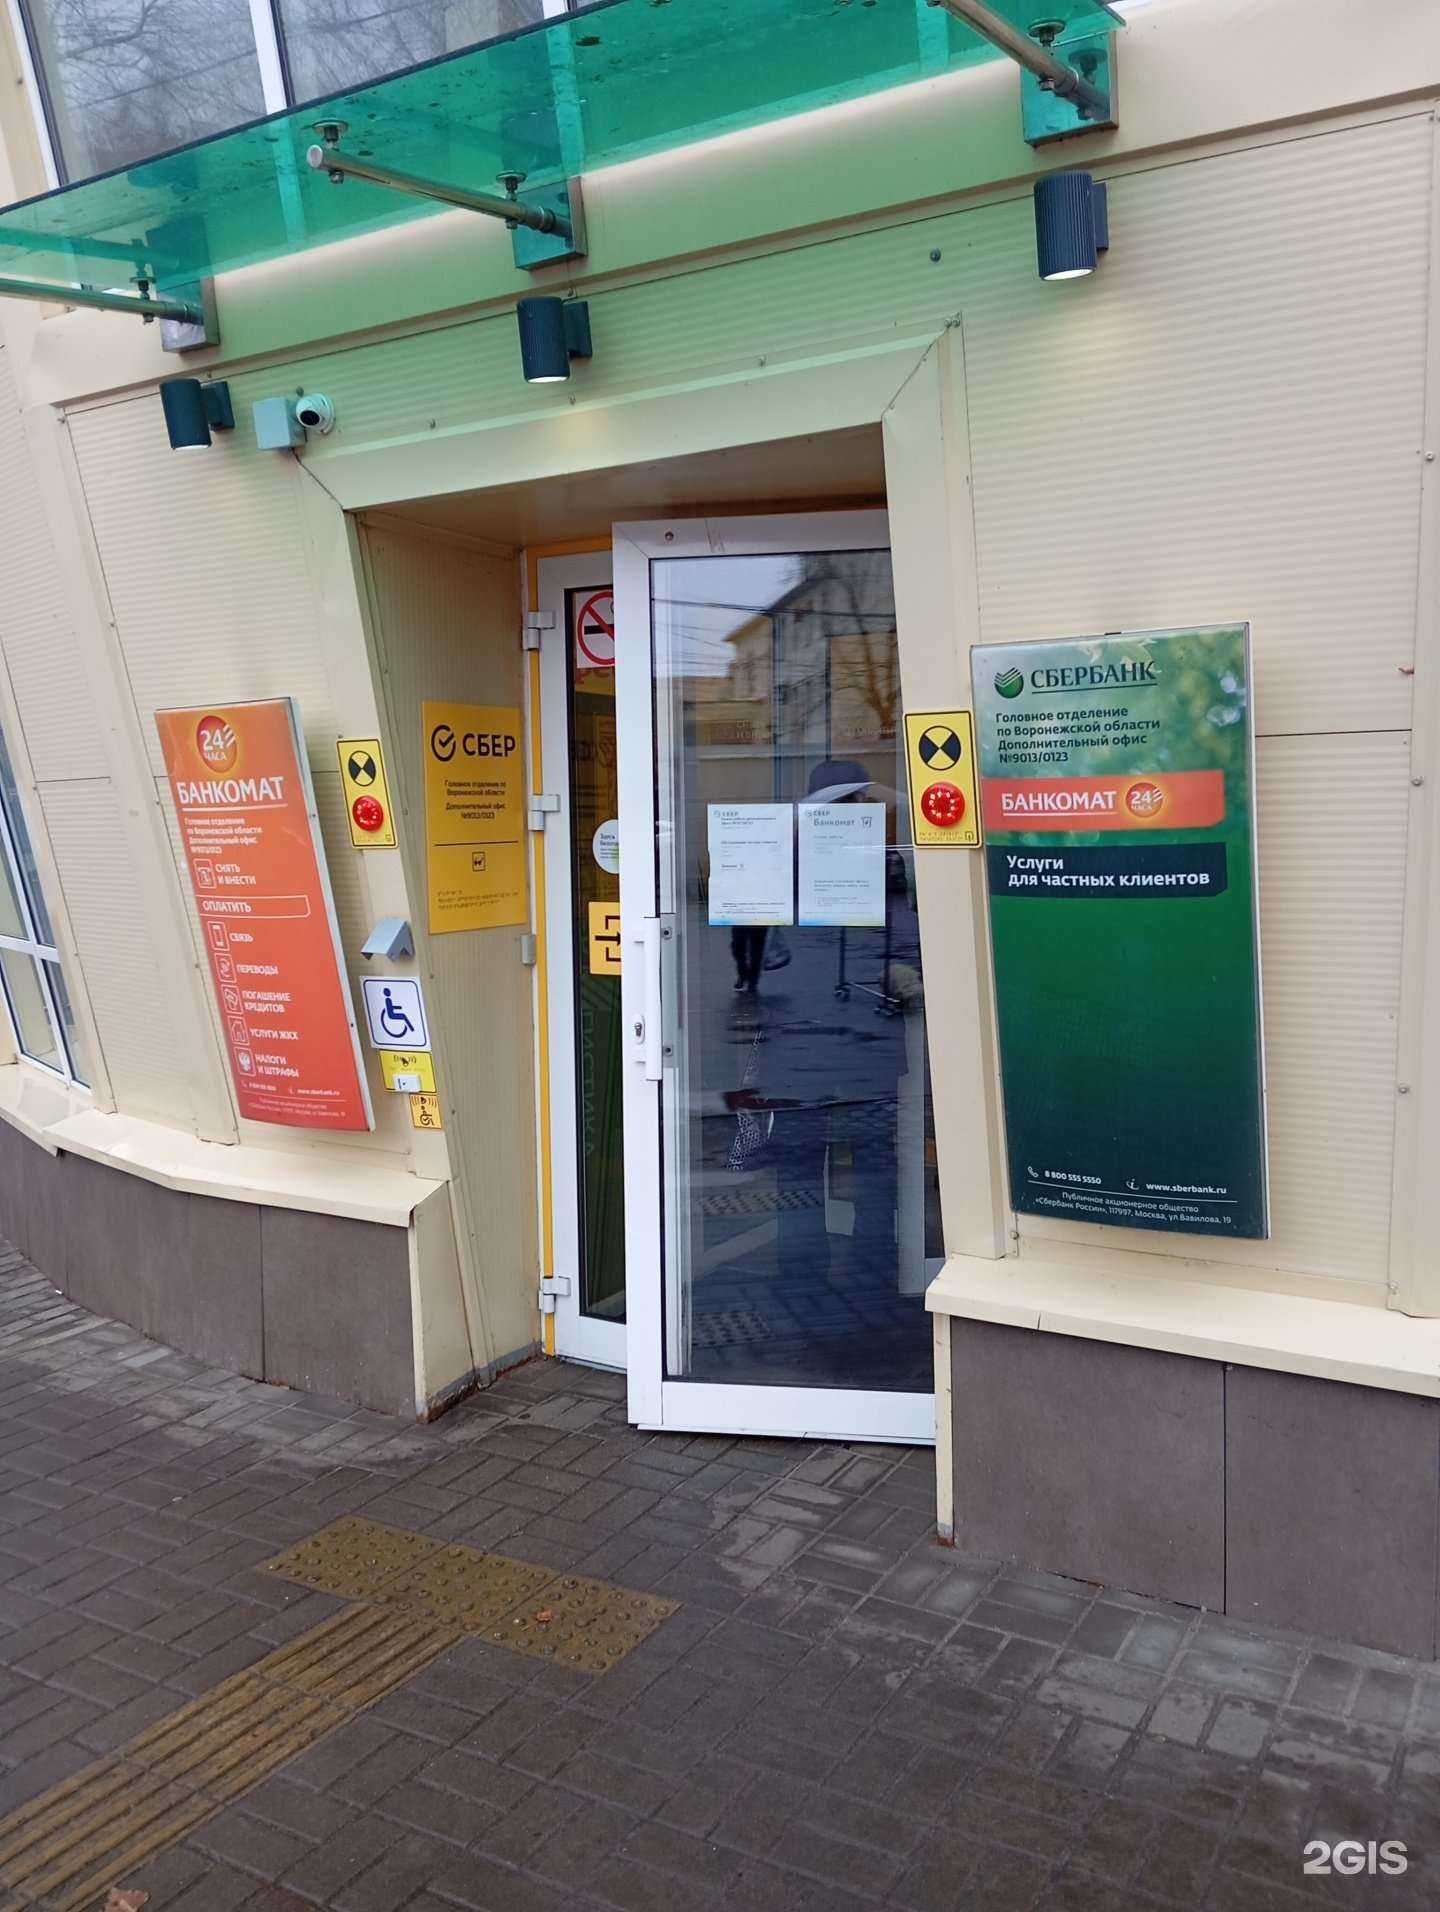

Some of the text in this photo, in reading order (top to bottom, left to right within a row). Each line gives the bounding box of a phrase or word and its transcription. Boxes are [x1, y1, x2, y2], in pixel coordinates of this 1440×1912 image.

[1031, 661, 1157, 688] СБЕРБАНК
[996, 707, 1128, 723] Головное отделение
[997, 719, 1160, 738] по Воронежской области
[201, 729, 225, 751] 24
[462, 732, 516, 758] СБЕР
[998, 734, 1147, 751] Дополнительный офис
[1000, 751, 1068, 764] №9013/0123
[176, 776, 284, 805] БАНКОМАТ
[1131, 791, 1153, 804] 24
[1001, 790, 1117, 811] БАНКОМАТ
[1007, 855, 1064, 871] Услуги
[1008, 872, 1210, 887] для частных клиентов
[202, 900, 252, 912] ОПЛАТИТЬ
[1044, 1170, 1050, 1178] 8
[1051, 1171, 1067, 1180] 800
[1145, 1183, 1227, 1194] www.sberbank.ru
[1159, 1203, 1199, 1213] общество
